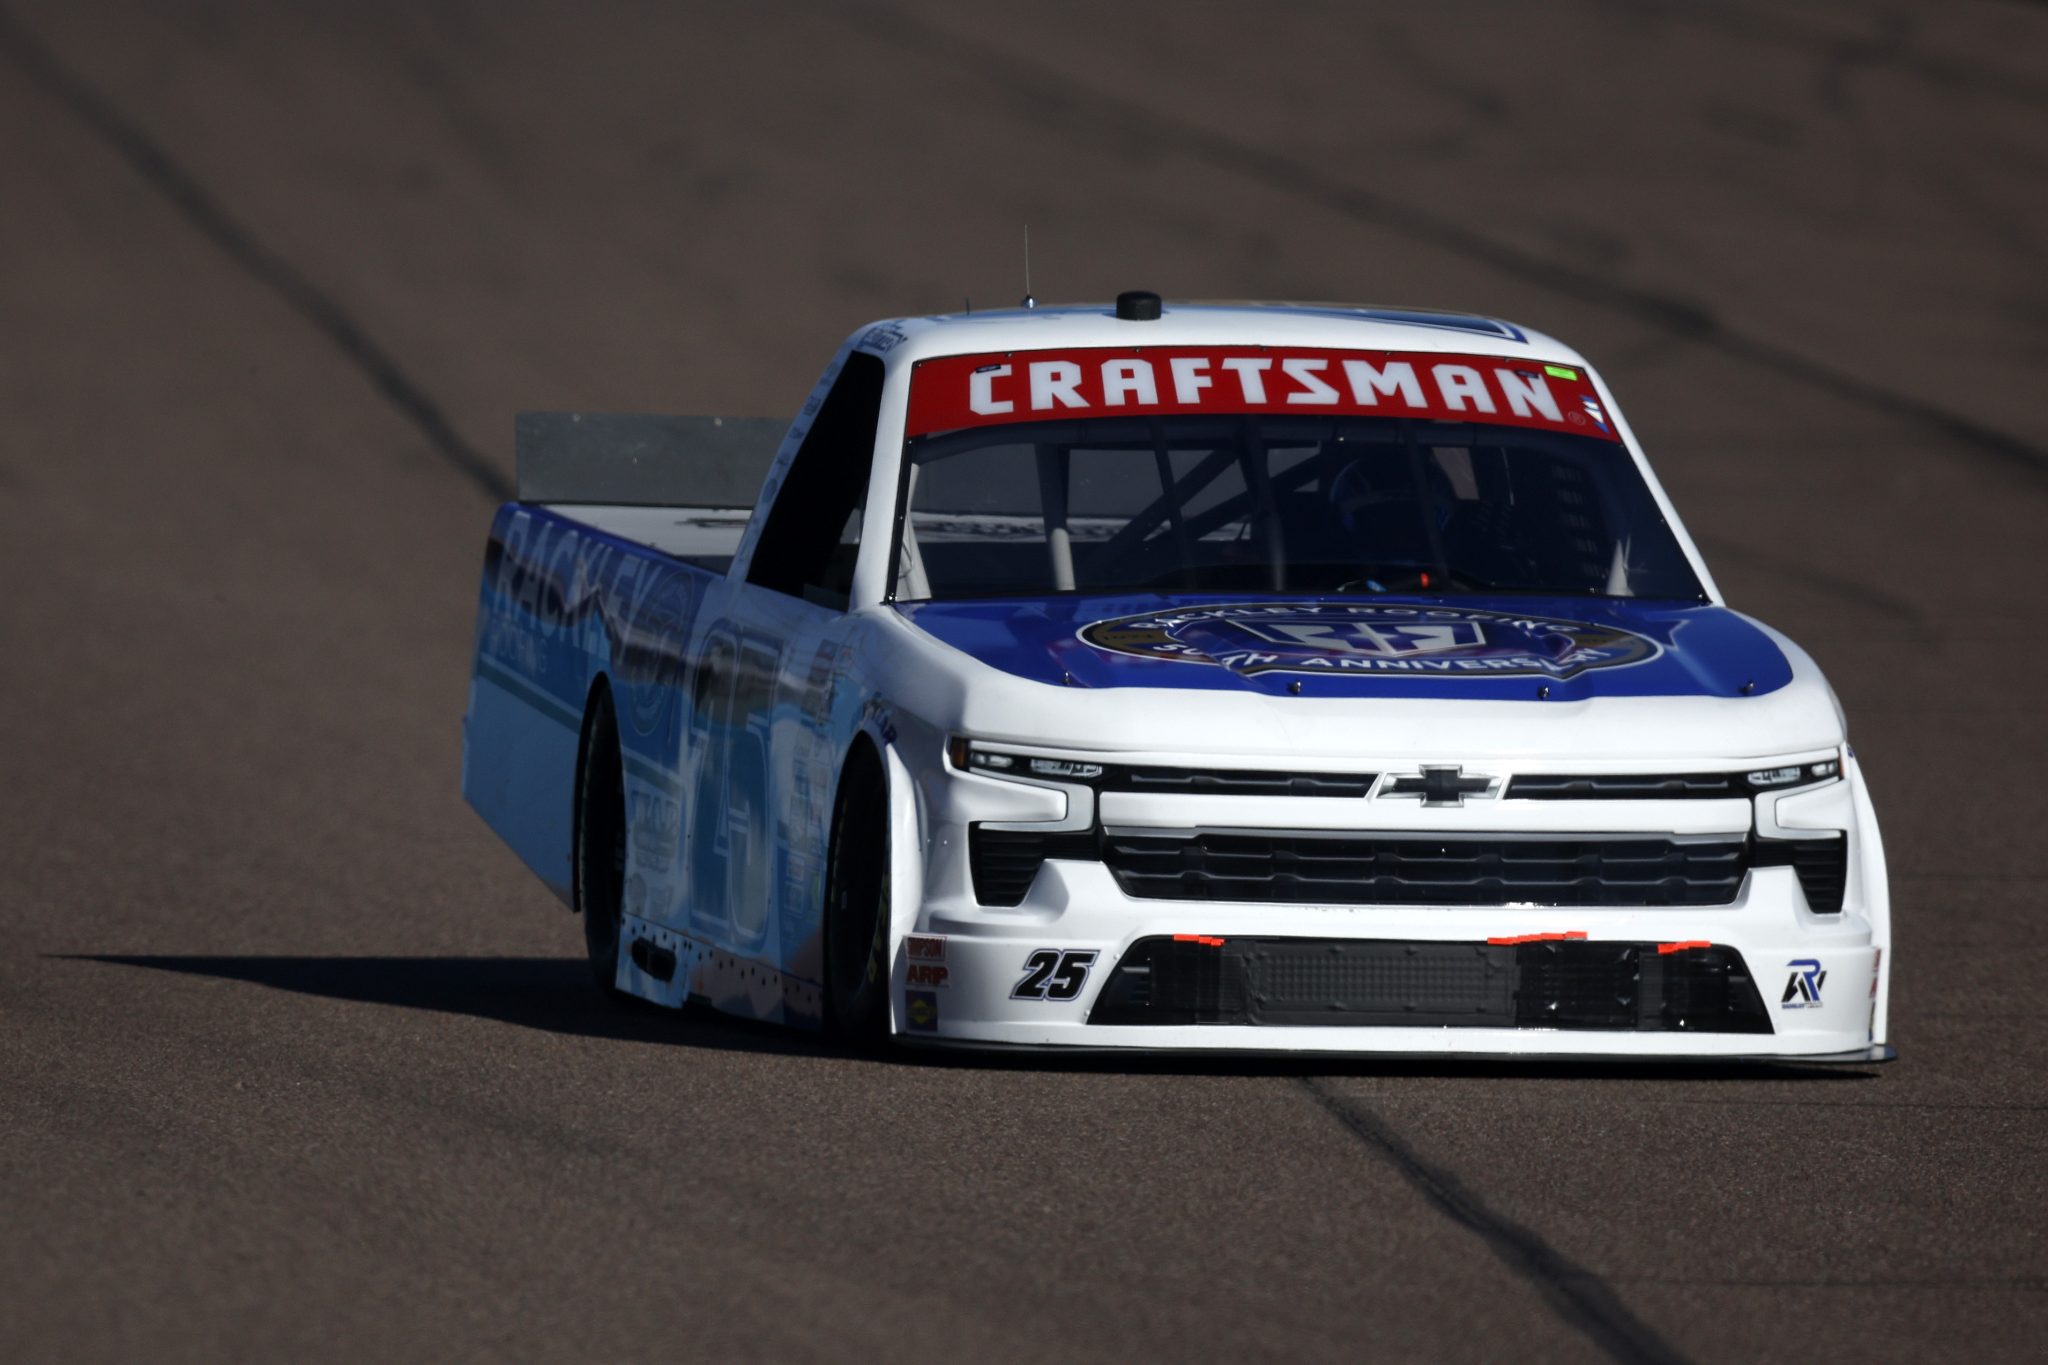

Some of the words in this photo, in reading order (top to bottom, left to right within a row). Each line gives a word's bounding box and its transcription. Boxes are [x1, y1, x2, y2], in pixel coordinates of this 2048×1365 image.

[969, 357, 1566, 423] CRAFTSMAN
[906, 964, 949, 985] ARP
[1009, 948, 1102, 1001] 25
